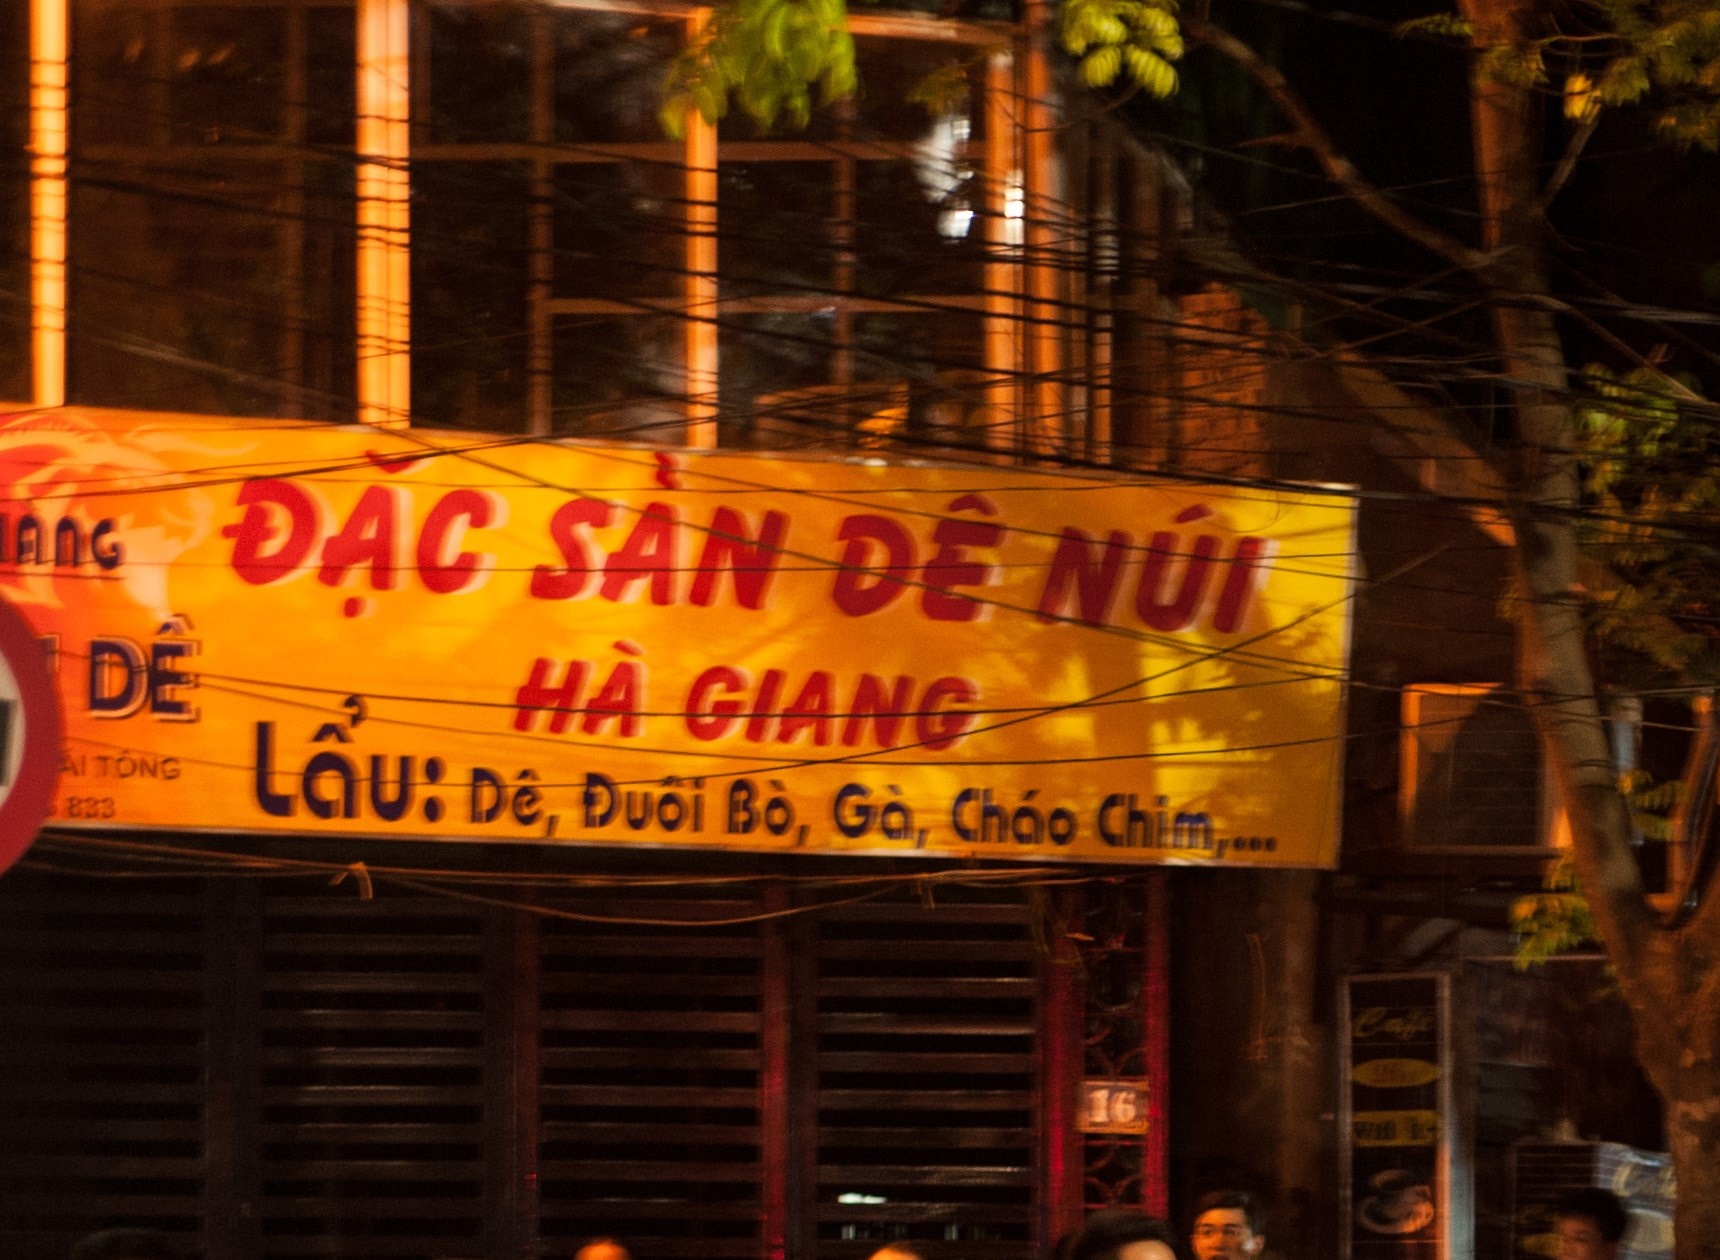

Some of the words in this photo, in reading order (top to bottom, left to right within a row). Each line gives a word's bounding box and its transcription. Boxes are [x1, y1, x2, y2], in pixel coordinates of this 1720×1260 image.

[221, 449, 500, 619] ĐẶC
[530, 450, 790, 611] SẢN
[832, 494, 1004, 621] DÊ
[1035, 502, 1273, 634] NÚI
[88, 613, 202, 722] DÊ
[513, 639, 648, 737] HÀ
[683, 665, 982, 751] GIANG
[471, 766, 560, 838] Dê,
[726, 778, 812, 847] Bò,
[832, 782, 928, 850] Gà,
[952, 787, 1078, 847] Cháo
[1088, 1088, 1137, 1123] 16
